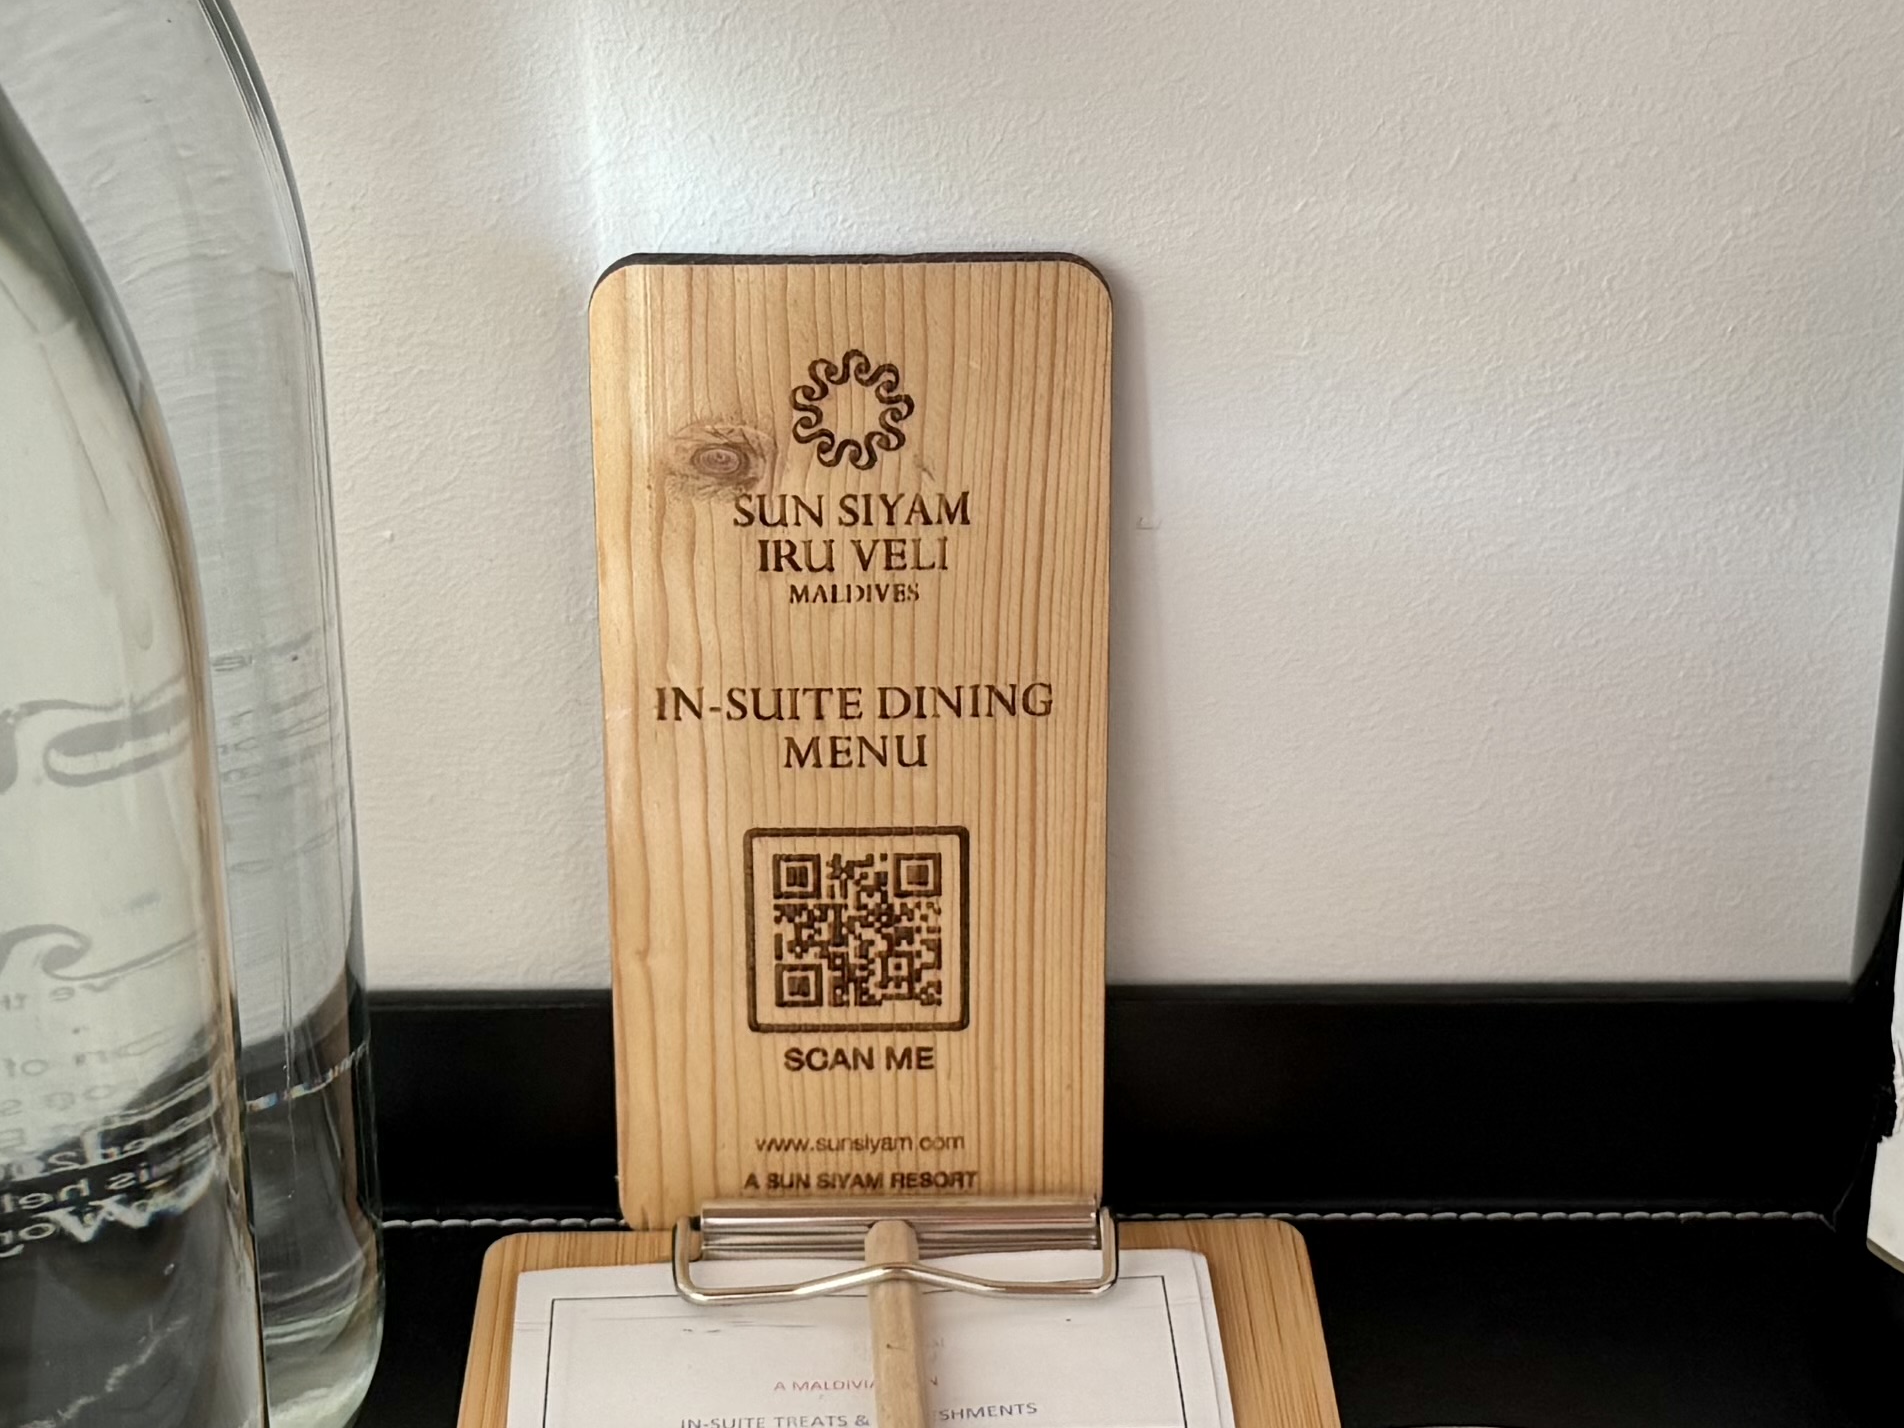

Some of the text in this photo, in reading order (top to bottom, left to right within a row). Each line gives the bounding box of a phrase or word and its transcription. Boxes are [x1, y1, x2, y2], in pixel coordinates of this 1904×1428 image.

[733, 491, 970, 527] SUN SIYAM
[758, 536, 948, 572] IRU VELI
[789, 583, 920, 604] MALDIVES
[656, 682, 1053, 721] IN-SUITE DINING
[784, 734, 928, 768] MENU
[784, 1047, 934, 1072] SCAN ME
[756, 1134, 964, 1154] www.sunsiyam.com
[744, 1170, 978, 1189] A SUN SIYAM RESORT
[775, 1416, 848, 1428] TREATS
